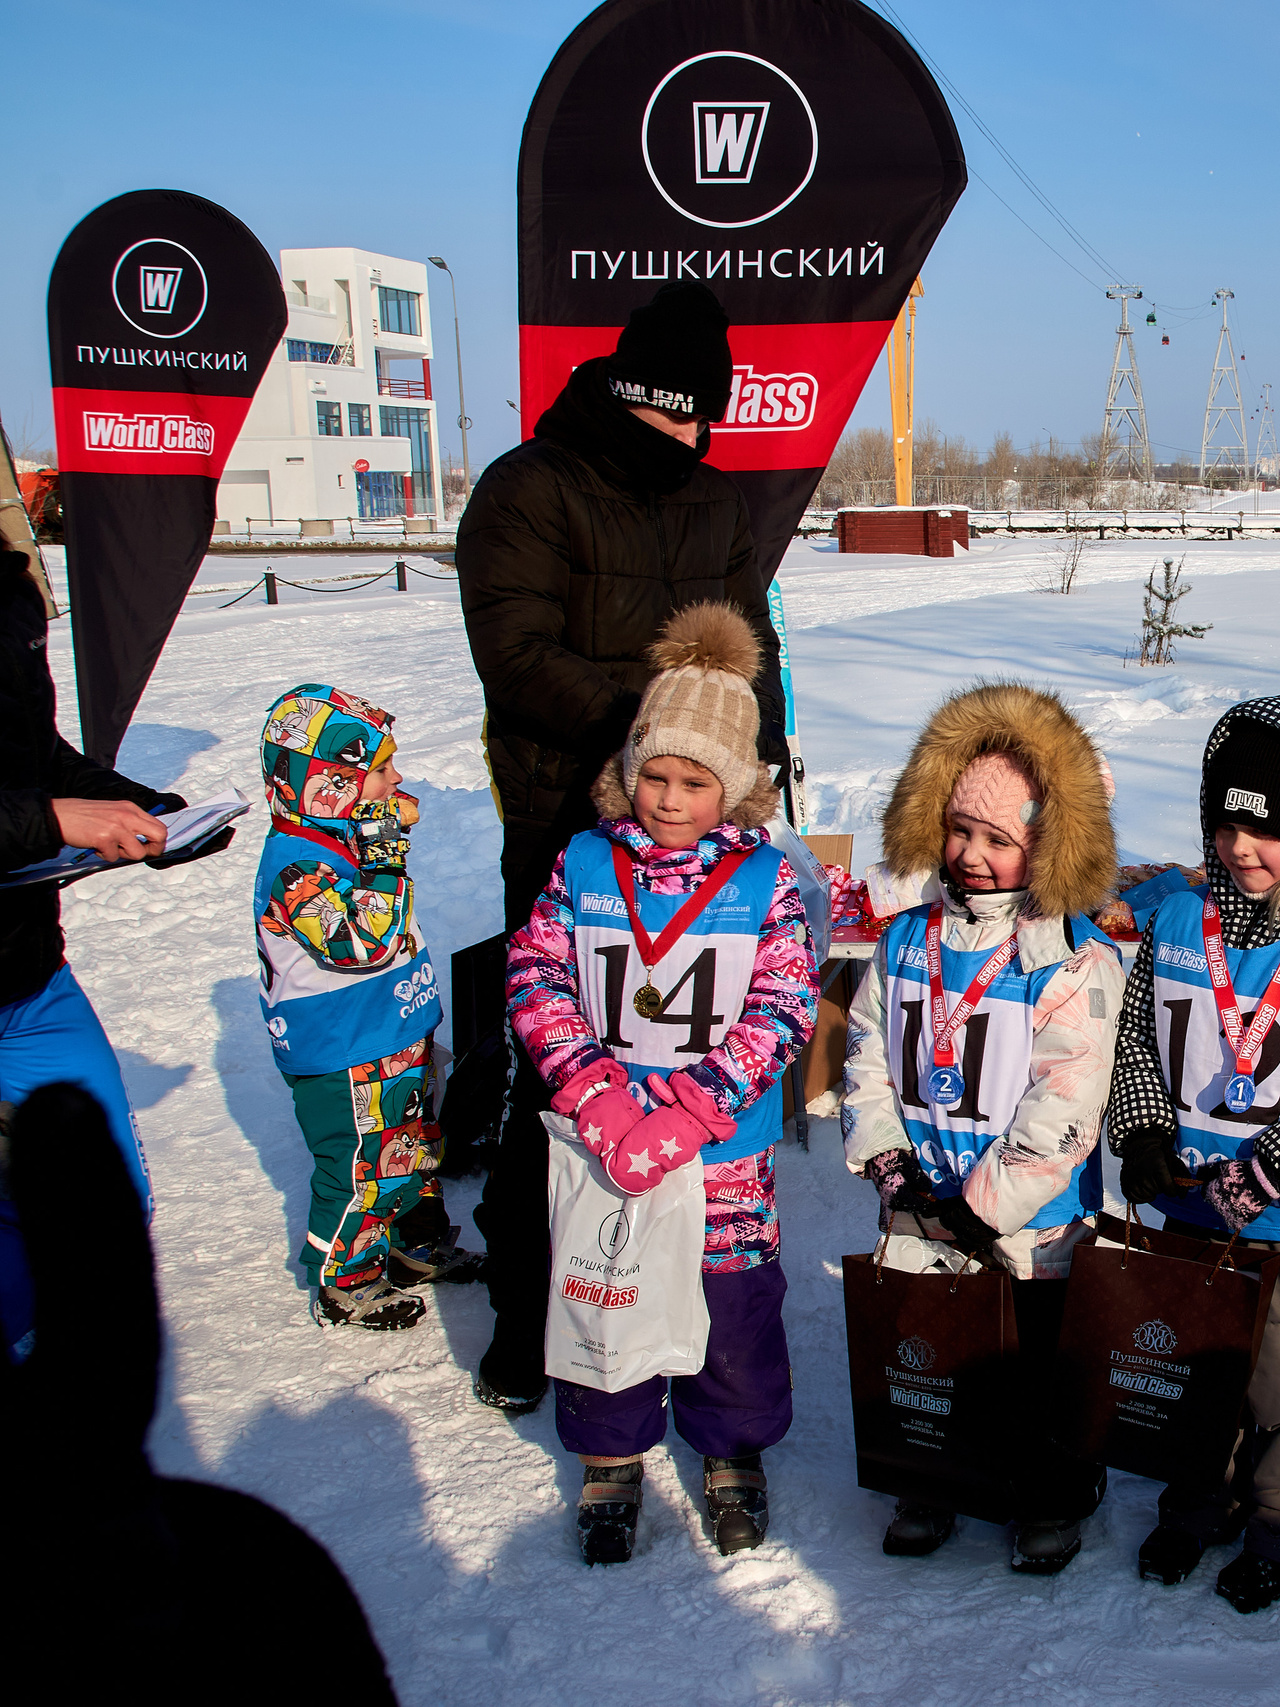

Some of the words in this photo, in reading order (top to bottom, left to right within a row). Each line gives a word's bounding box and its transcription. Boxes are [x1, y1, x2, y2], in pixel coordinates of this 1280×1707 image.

[571, 241, 884, 280] ПУШКИНСКИЙ
[77, 344, 248, 372] ПУШКИНСКИЙ
[724, 374, 812, 424] lass
[89, 417, 159, 449] World
[164, 419, 211, 451] Class
[583, 894, 614, 912] World
[929, 927, 938, 949] Class
[1208, 935, 1220, 961] World
[930, 948, 940, 977] World
[994, 940, 1018, 964] World
[1156, 944, 1182, 966] World
[1181, 950, 1207, 970] Class
[979, 958, 1000, 984] Class
[1212, 960, 1226, 986] Class
[594, 944, 725, 1053] 14
[934, 998, 945, 1020] Class
[950, 1002, 973, 1029] World
[1223, 1008, 1243, 1036] World
[1241, 1029, 1263, 1058] World
[1253, 1006, 1275, 1034] Class
[901, 999, 991, 1122] 11
[940, 1074, 952, 1092] 2
[1236, 1081, 1244, 1100] 1
[569, 1255, 640, 1278] ПУШКИНСКИЙ
[564, 1277, 604, 1304] World
[1109, 1350, 1191, 1376] Пушкинский
[885, 1366, 954, 1388] Пушкинский
[1112, 1371, 1148, 1391] World
[1147, 1378, 1180, 1398] Class
[892, 1388, 920, 1408] World
[920, 1395, 949, 1413] Class
